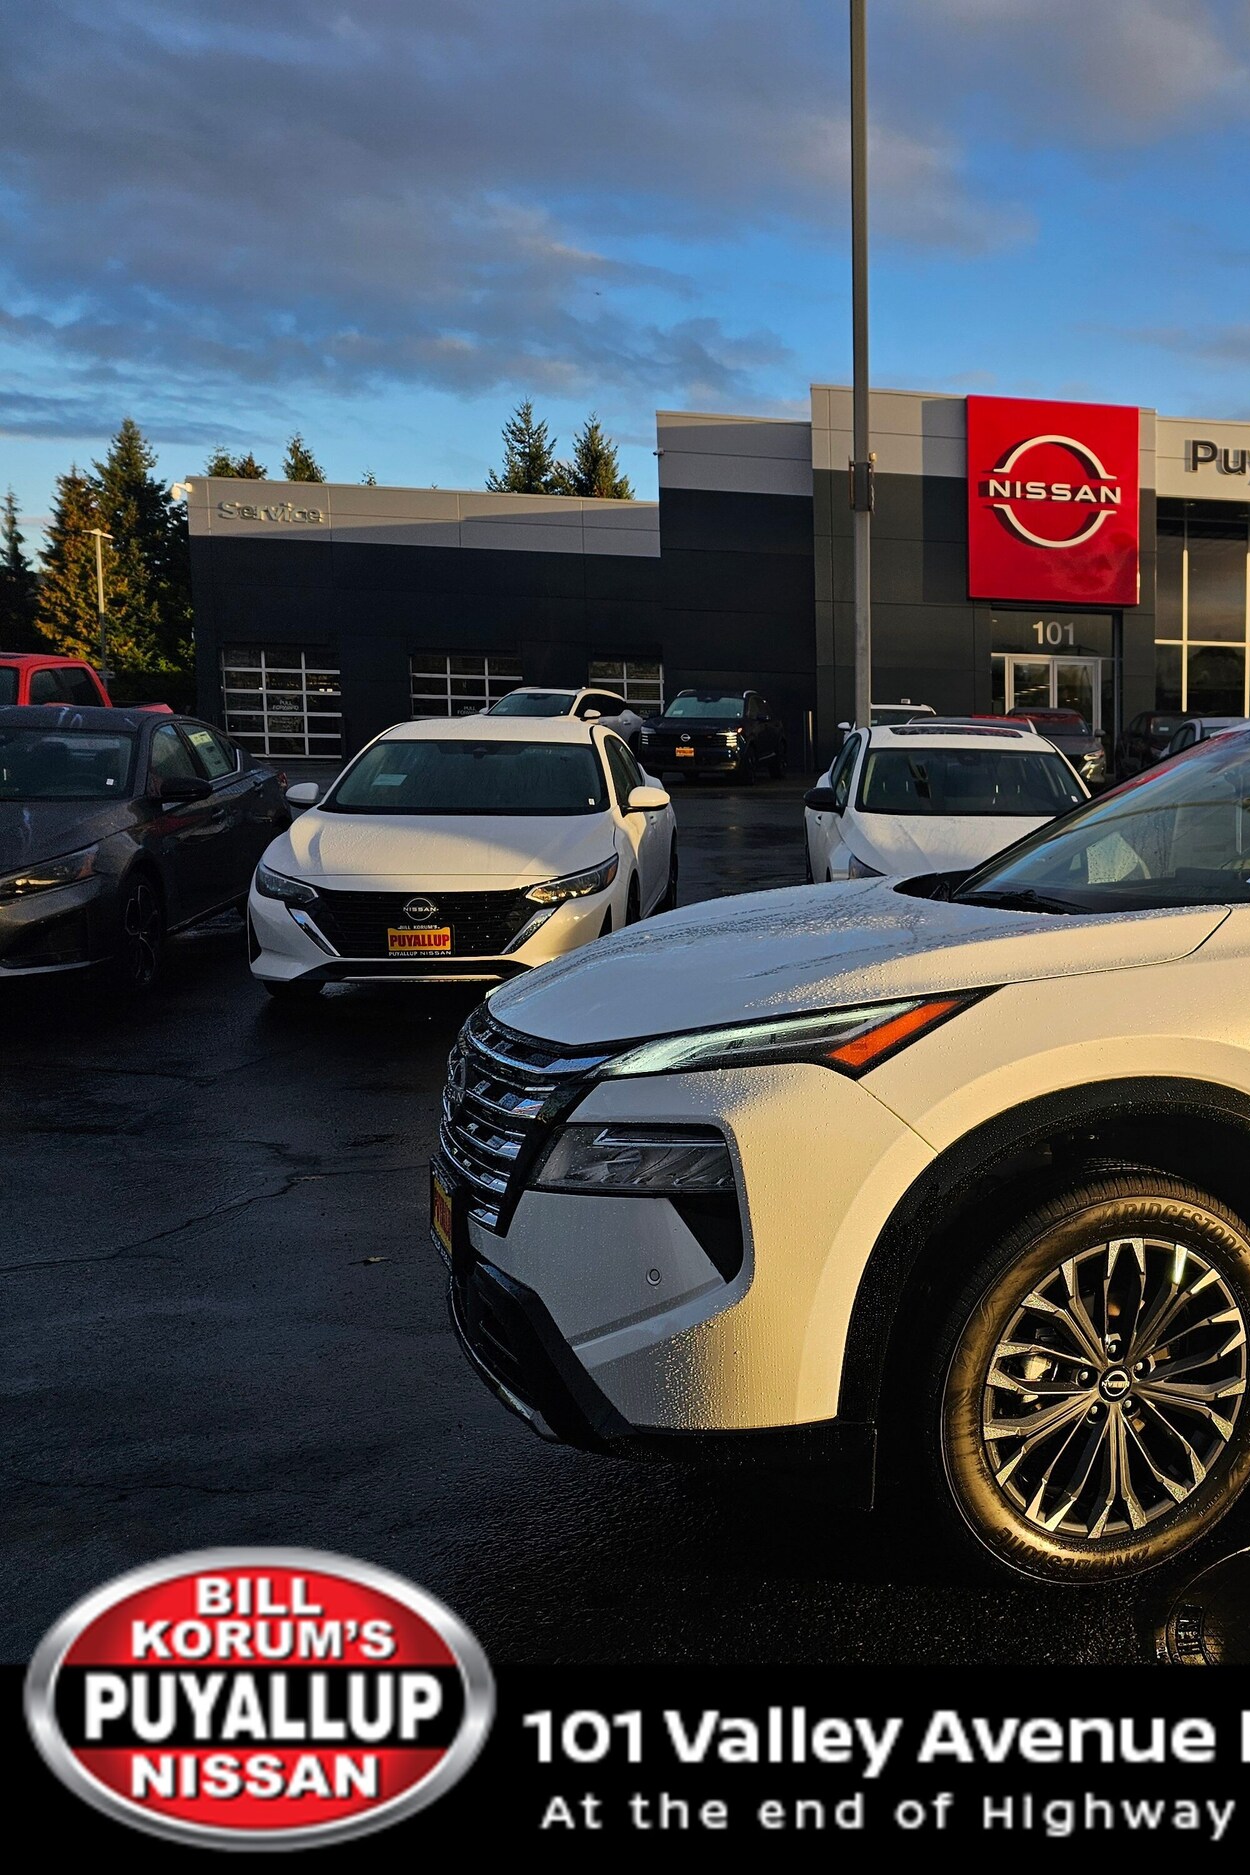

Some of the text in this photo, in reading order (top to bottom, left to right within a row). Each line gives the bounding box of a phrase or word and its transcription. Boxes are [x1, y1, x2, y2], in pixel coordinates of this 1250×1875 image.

[988, 478, 1122, 504] NISSAN
[218, 499, 324, 524] Service
[1032, 620, 1075, 645] 101
[389, 934, 450, 947] PUYALLUP
